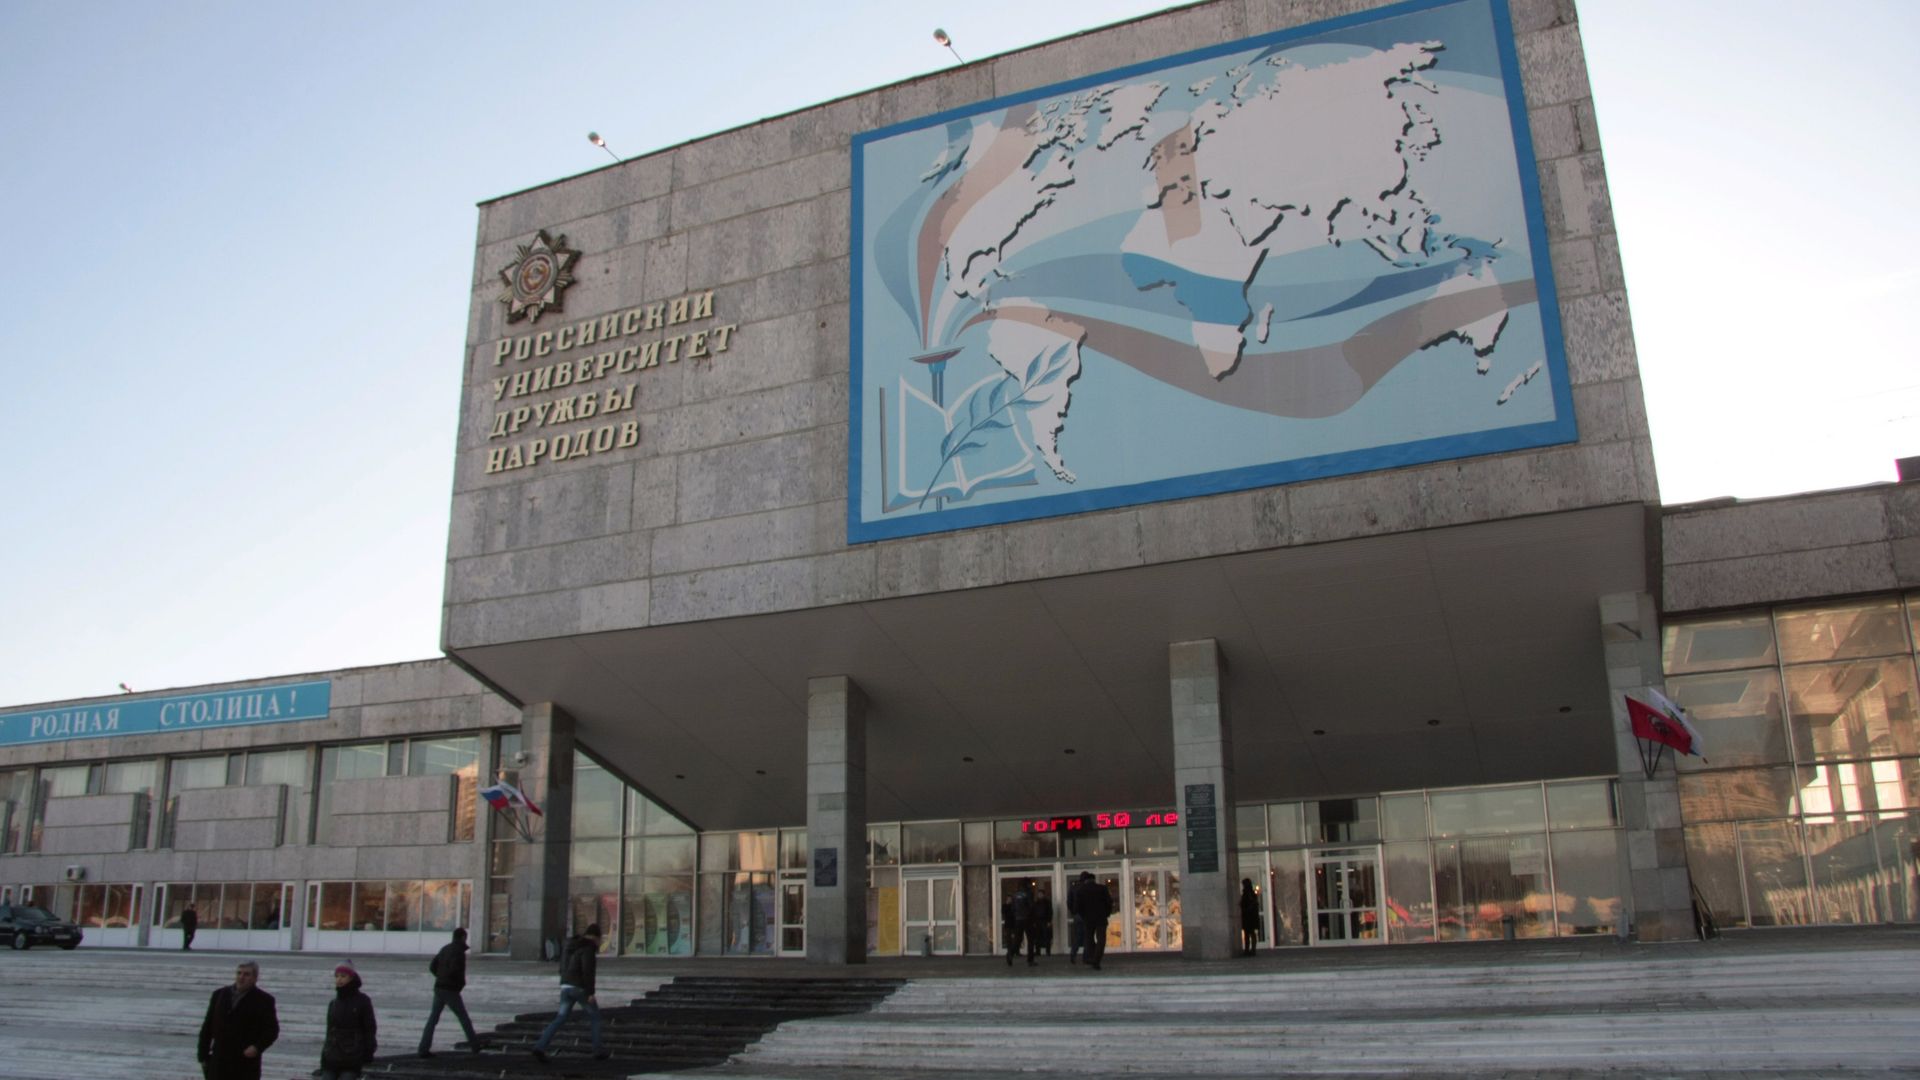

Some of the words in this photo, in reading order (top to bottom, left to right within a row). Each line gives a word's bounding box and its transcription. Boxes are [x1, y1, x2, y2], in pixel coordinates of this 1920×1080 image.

[492, 324, 738, 401] УНИВЕРСИТЕТ
[488, 384, 638, 440] ДРУЖБЫ
[484, 420, 640, 475] НАРОДОВ
[29, 708, 120, 738] РОДНАЯ
[1096, 811, 1131, 829] 50
